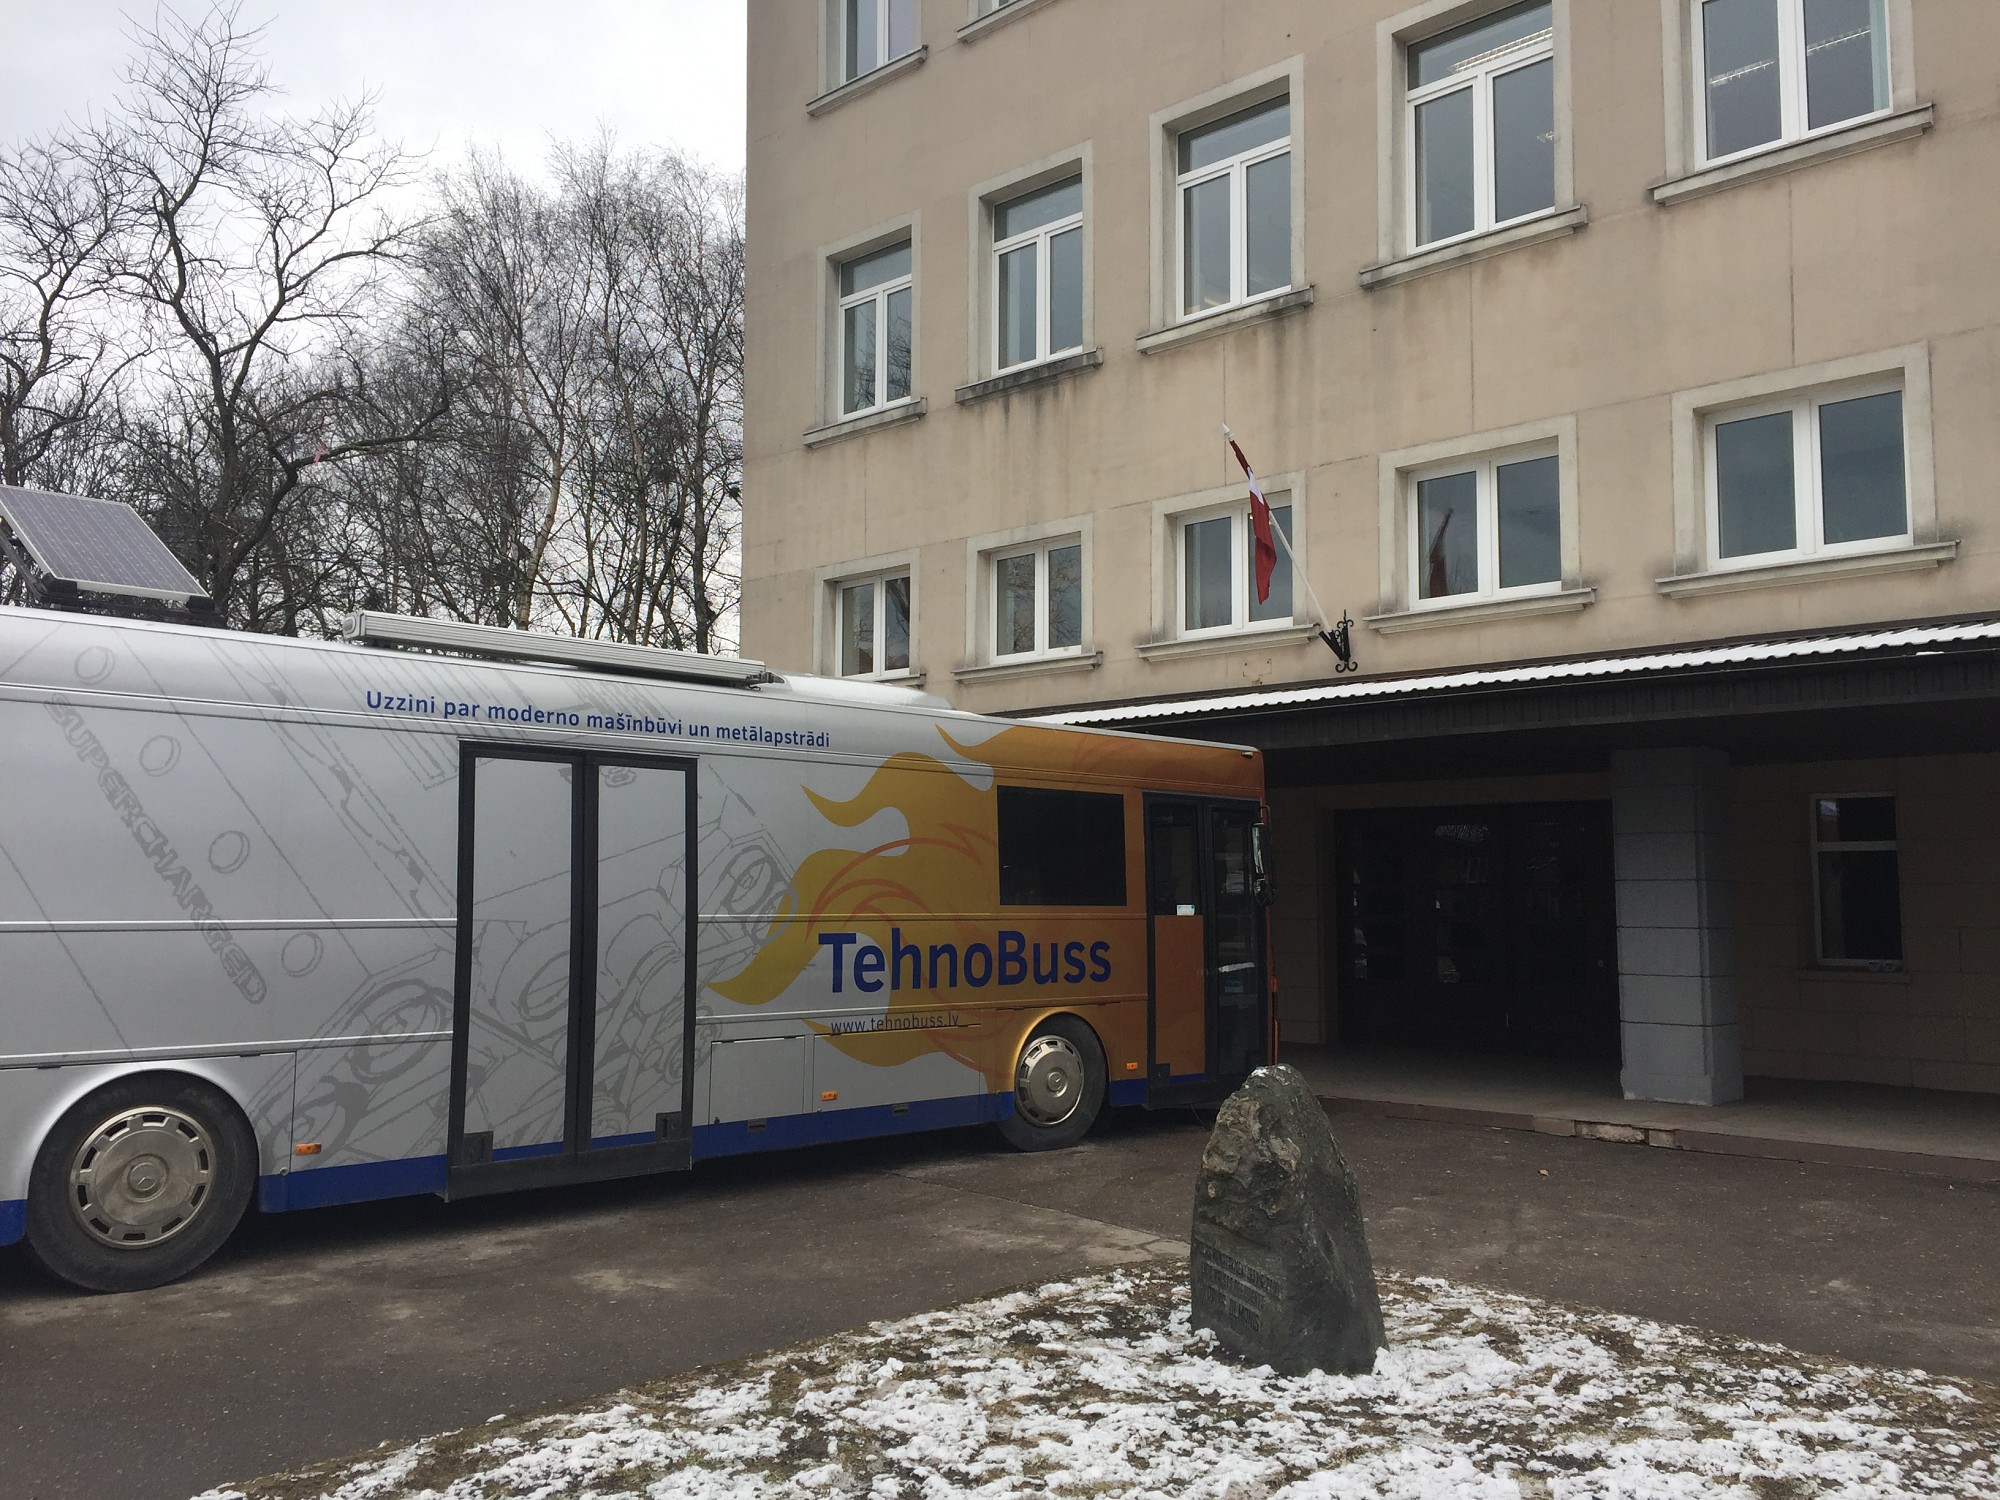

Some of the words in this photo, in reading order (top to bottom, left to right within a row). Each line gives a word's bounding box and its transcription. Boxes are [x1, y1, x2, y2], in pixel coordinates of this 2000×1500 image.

[366, 690, 436, 714] Uzzini
[443, 699, 480, 719] par
[487, 704, 580, 726] moderno
[586, 712, 682, 735] mašīnbūvi
[689, 723, 710, 738] un
[716, 725, 830, 747] metālapstrādi
[46, 693, 267, 1004] SUPERCHARGED
[818, 928, 1112, 993] TehnoBuss
[830, 1012, 960, 1034] www.tehnobuss.lv
